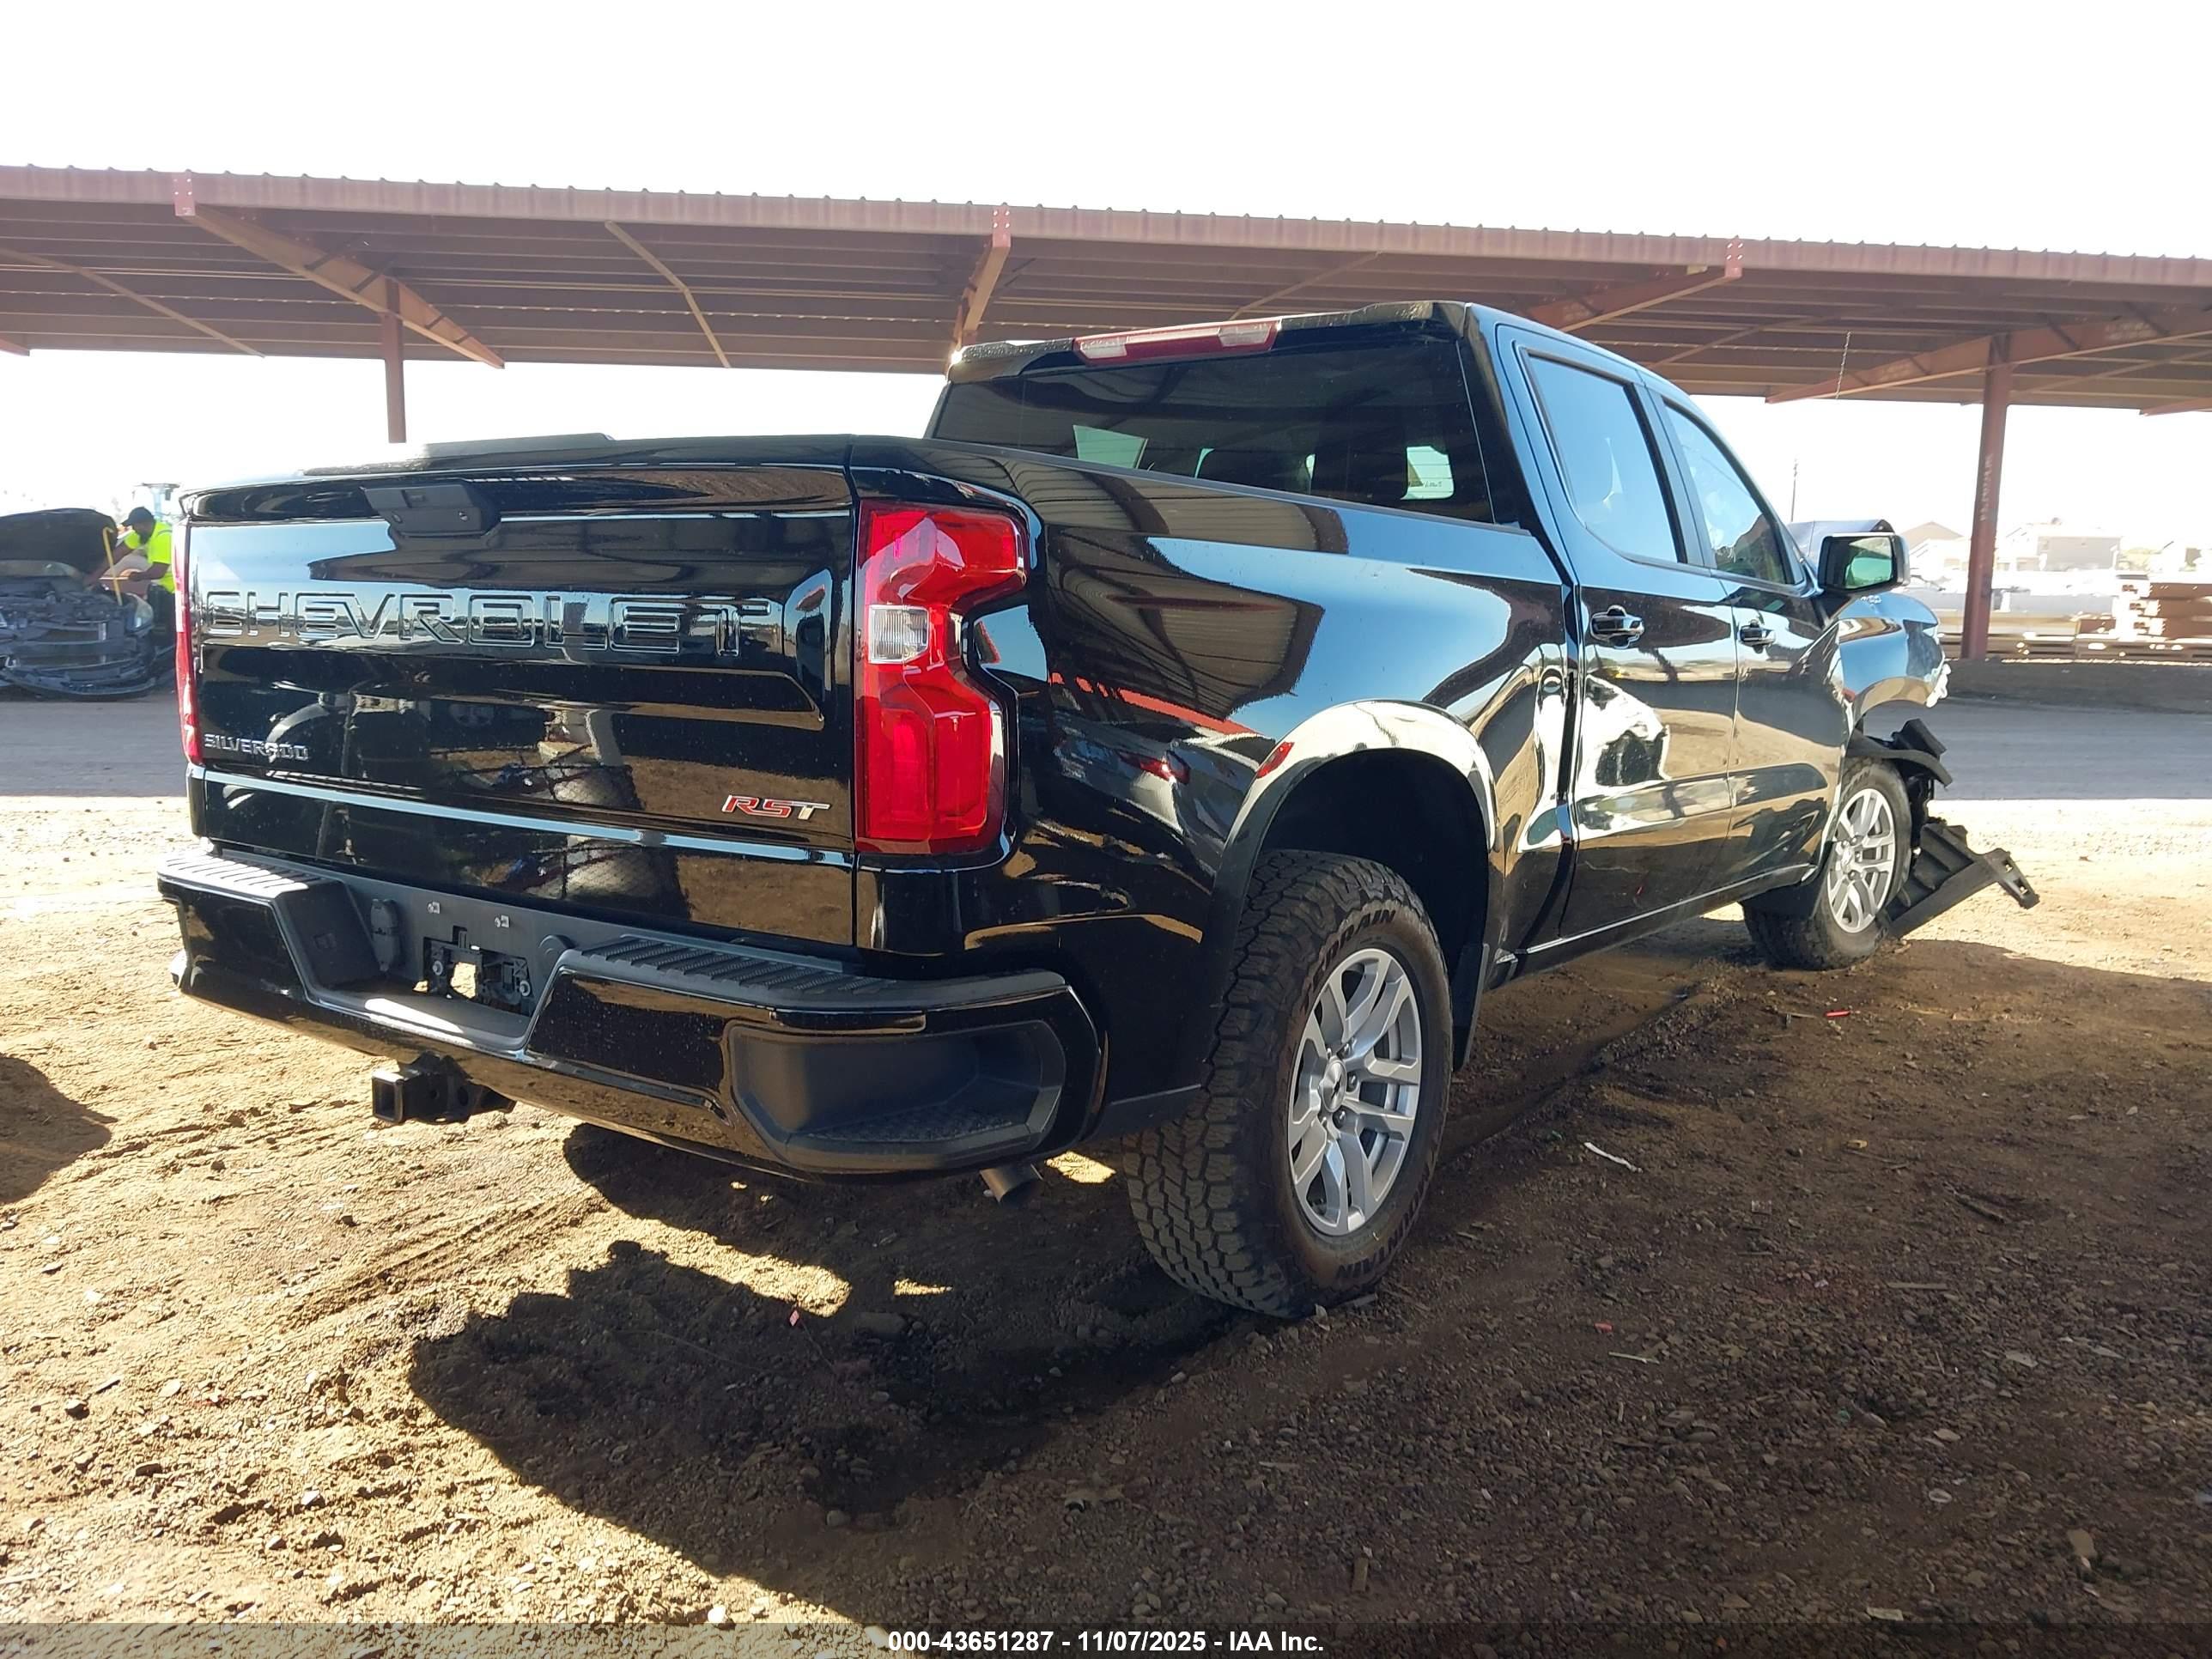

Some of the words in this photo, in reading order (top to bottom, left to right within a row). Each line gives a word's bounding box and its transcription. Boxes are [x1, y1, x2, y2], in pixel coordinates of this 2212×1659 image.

[205, 590, 771, 657] CHEVROLET
[204, 733, 309, 762] SILVERADO
[721, 794, 830, 821] RST
